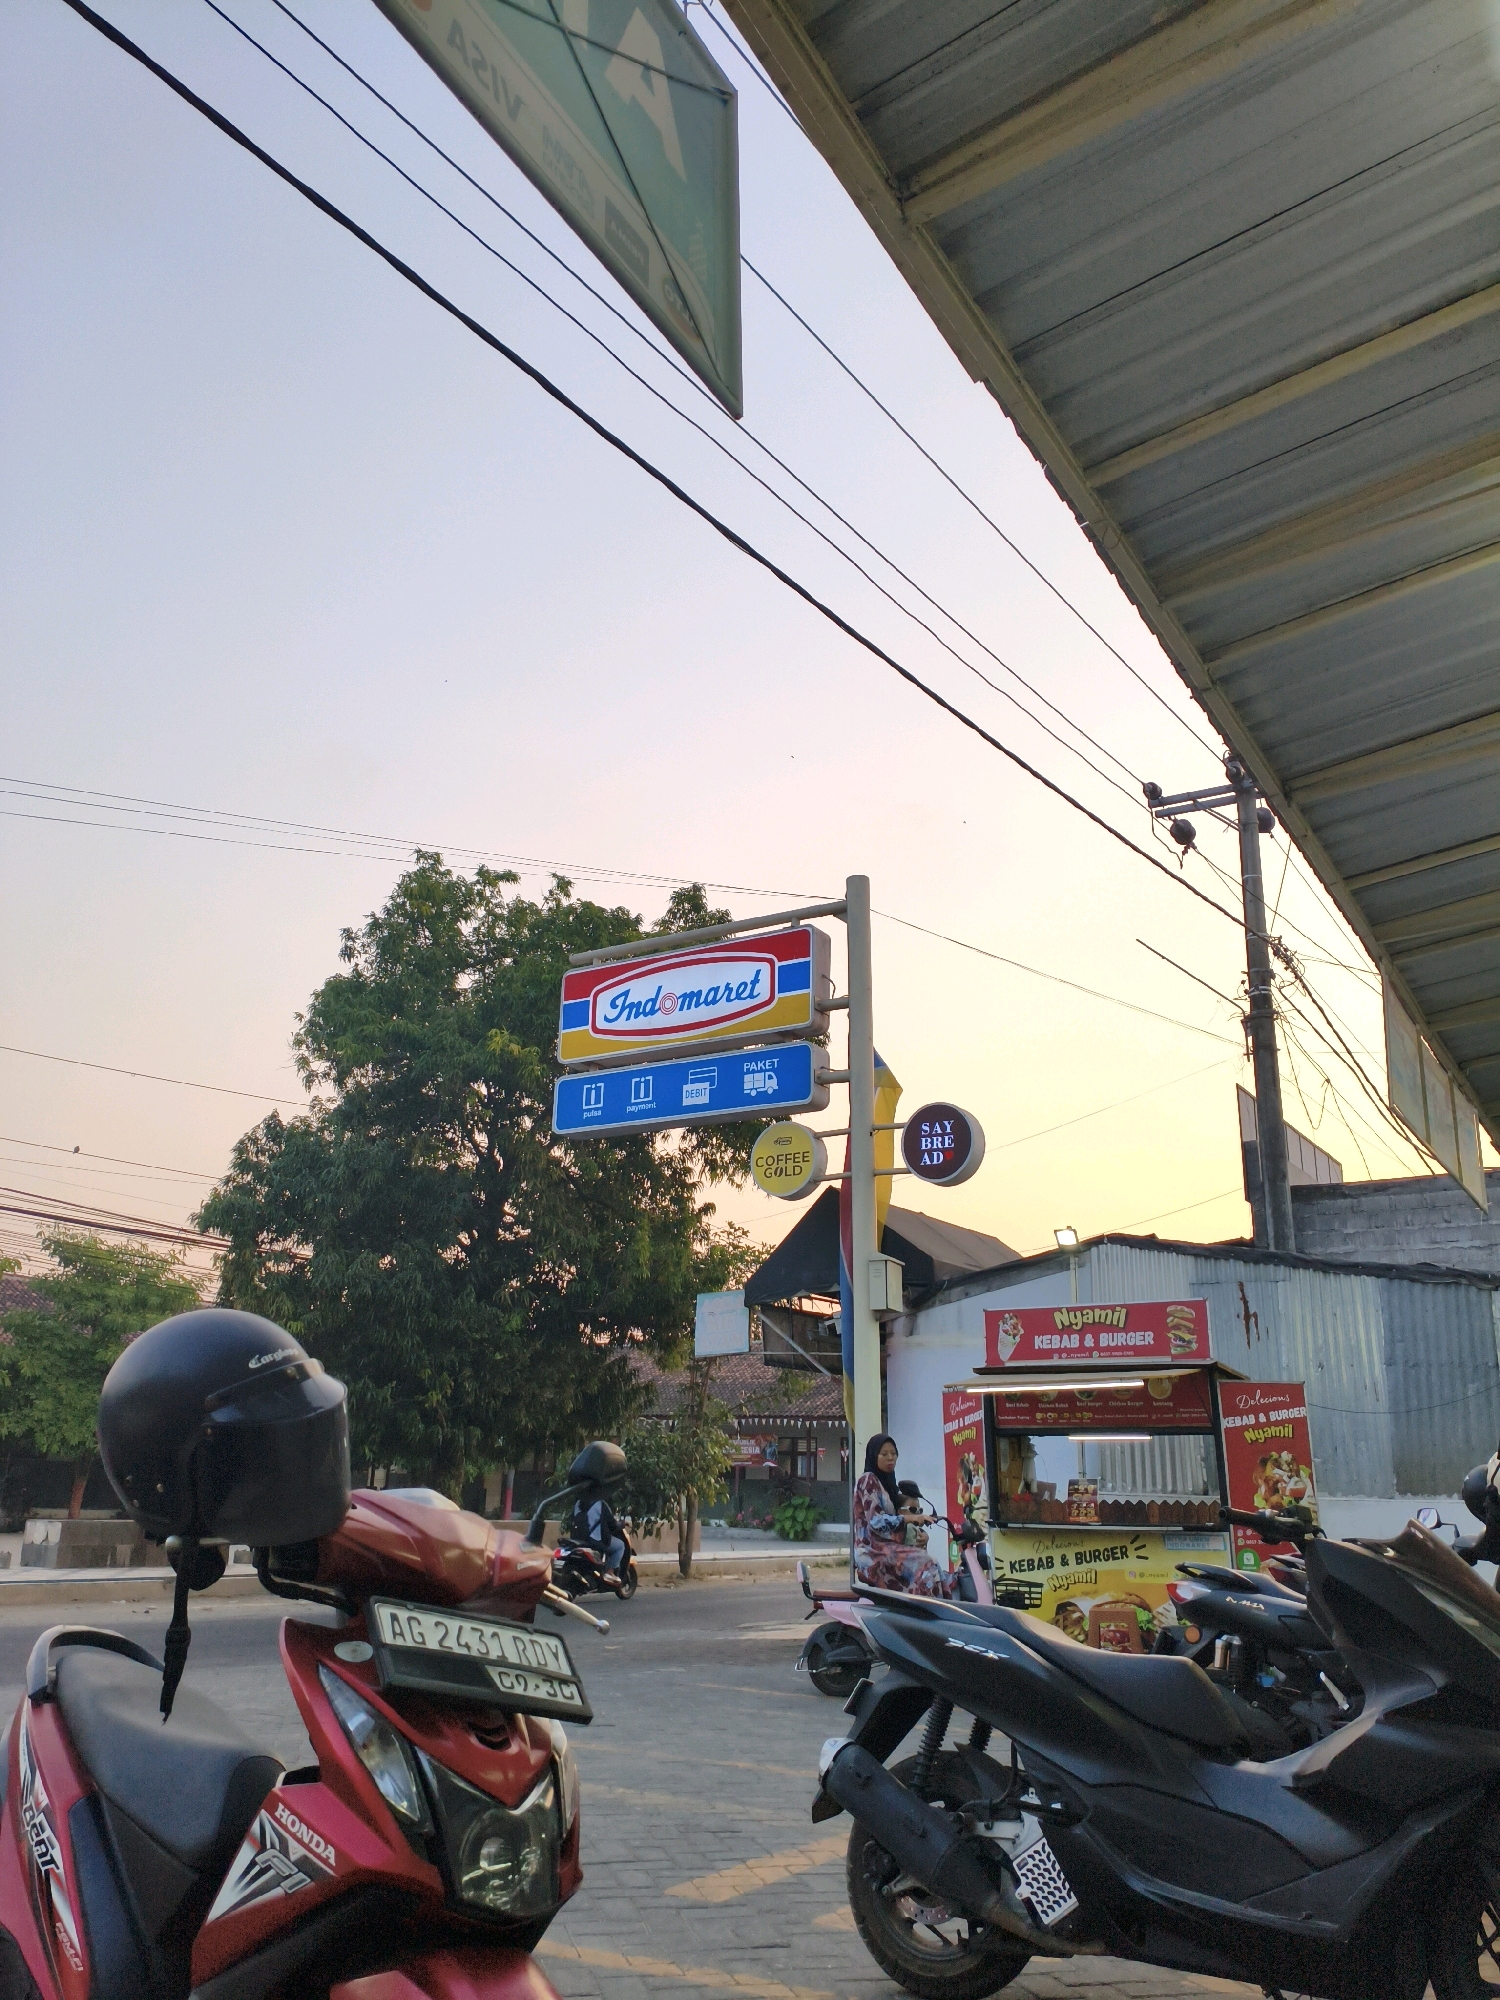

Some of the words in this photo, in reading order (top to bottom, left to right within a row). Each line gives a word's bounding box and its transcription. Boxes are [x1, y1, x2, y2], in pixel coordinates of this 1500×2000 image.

[603, 968, 761, 1023] Indomaret
[743, 1058, 779, 1071] PAKET
[685, 1087, 707, 1099] DEBIT
[583, 1109, 602, 1119] pulsa
[626, 1101, 657, 1113] payment
[921, 1120, 954, 1135] SAY
[921, 1135, 954, 1150] BRE
[755, 1151, 810, 1168] COFFEE
[920, 1151, 944, 1165] AD
[763, 1165, 803, 1179] GOLD
[1053, 1306, 1128, 1331] Nyamil
[1034, 1334, 1080, 1350] KEBAB
[1084, 1333, 1095, 1348] &
[1099, 1331, 1154, 1347] BURGER
[1222, 1414, 1255, 1429] KEBAB
[1258, 1412, 1267, 1423] &
[1269, 1407, 1307, 1421] BURGER
[952, 1427, 976, 1446] Nyamil
[1243, 1424, 1293, 1444] Nyamil
[1009, 1555, 1055, 1574] KEBAB
[1060, 1553, 1070, 1567] &
[1075, 1545, 1130, 1566] BURGER
[1047, 1568, 1097, 1592] Nyamil
[389, 1612, 427, 1647] AG
[434, 1620, 509, 1661] 2431
[512, 1635, 563, 1669] RDY
[274, 1802, 336, 1867] HONDA
